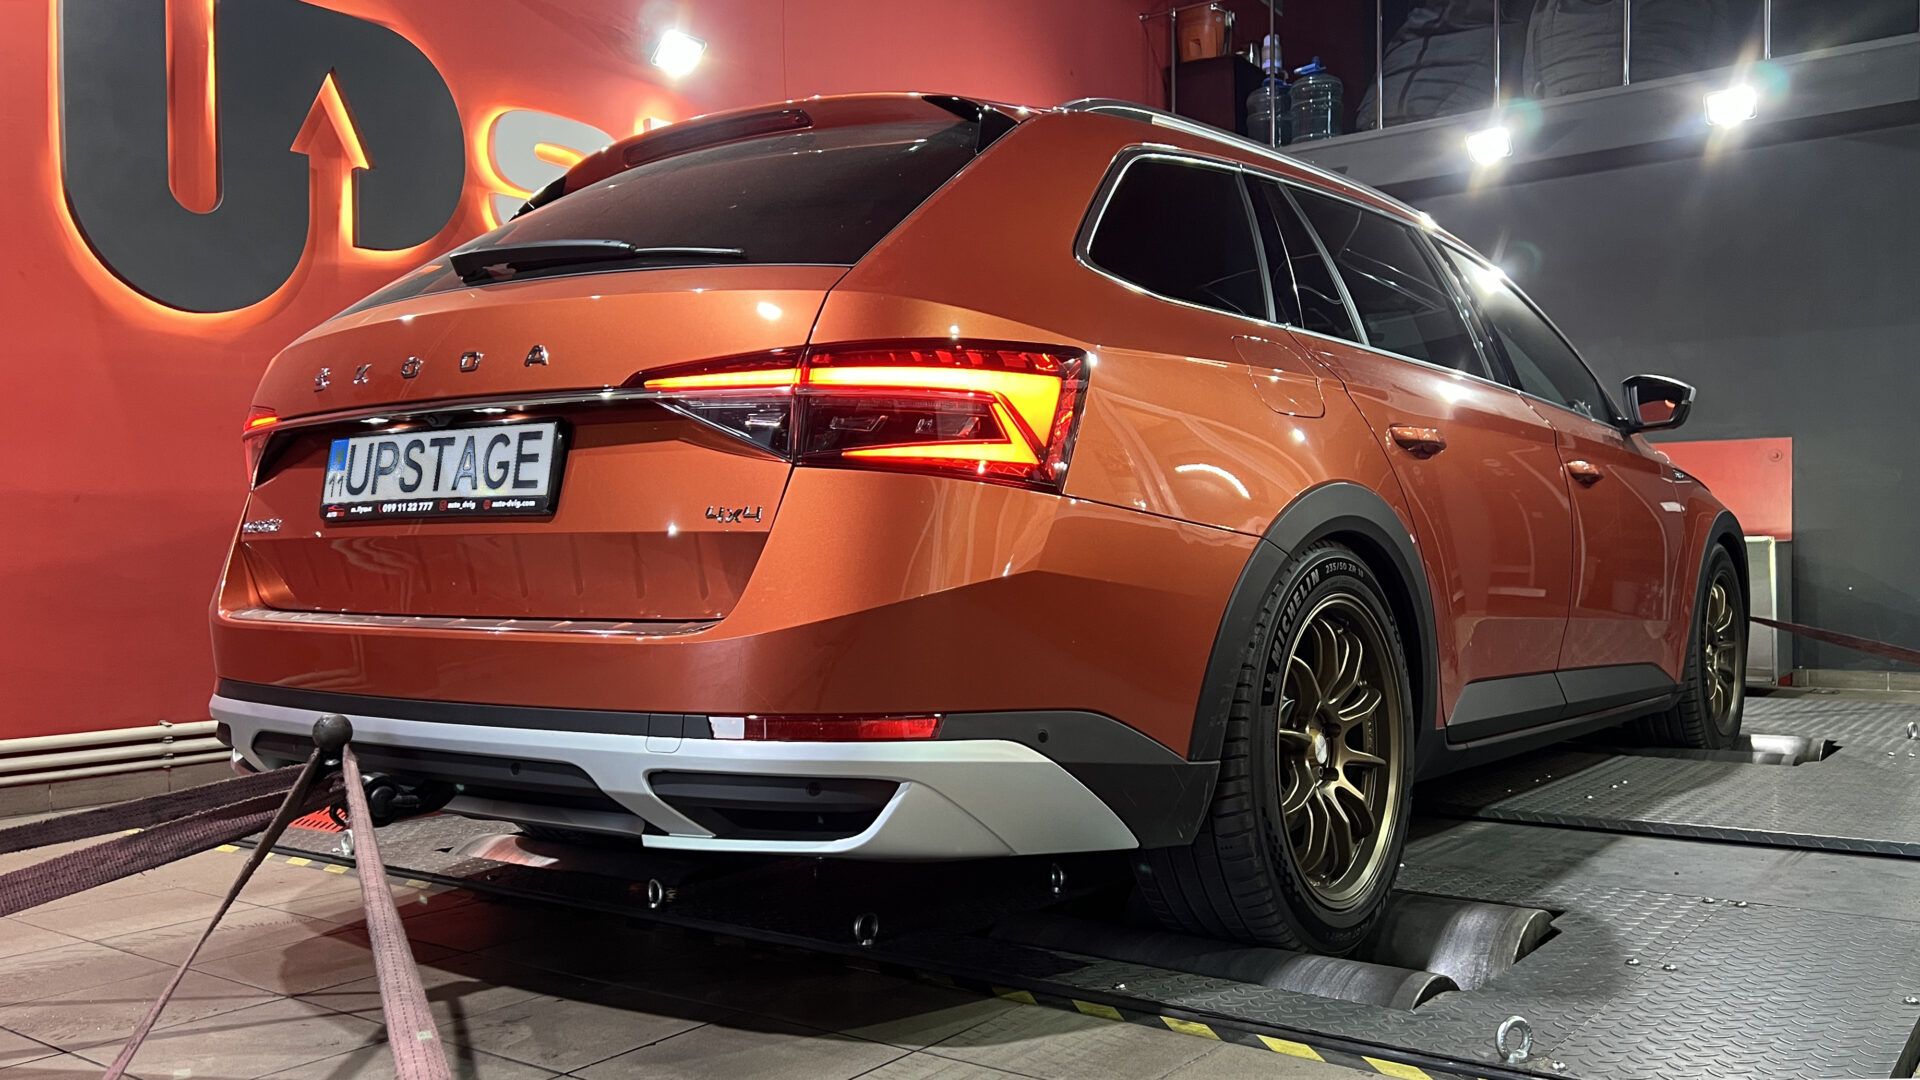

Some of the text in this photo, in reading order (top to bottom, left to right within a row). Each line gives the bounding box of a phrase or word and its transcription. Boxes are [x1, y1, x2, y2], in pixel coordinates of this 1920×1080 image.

[346, 431, 543, 496] UPSTAGE
[329, 475, 344, 498] 11
[382, 501, 434, 513] 099 11 22 777
[1271, 568, 1320, 667] MICHELIN
